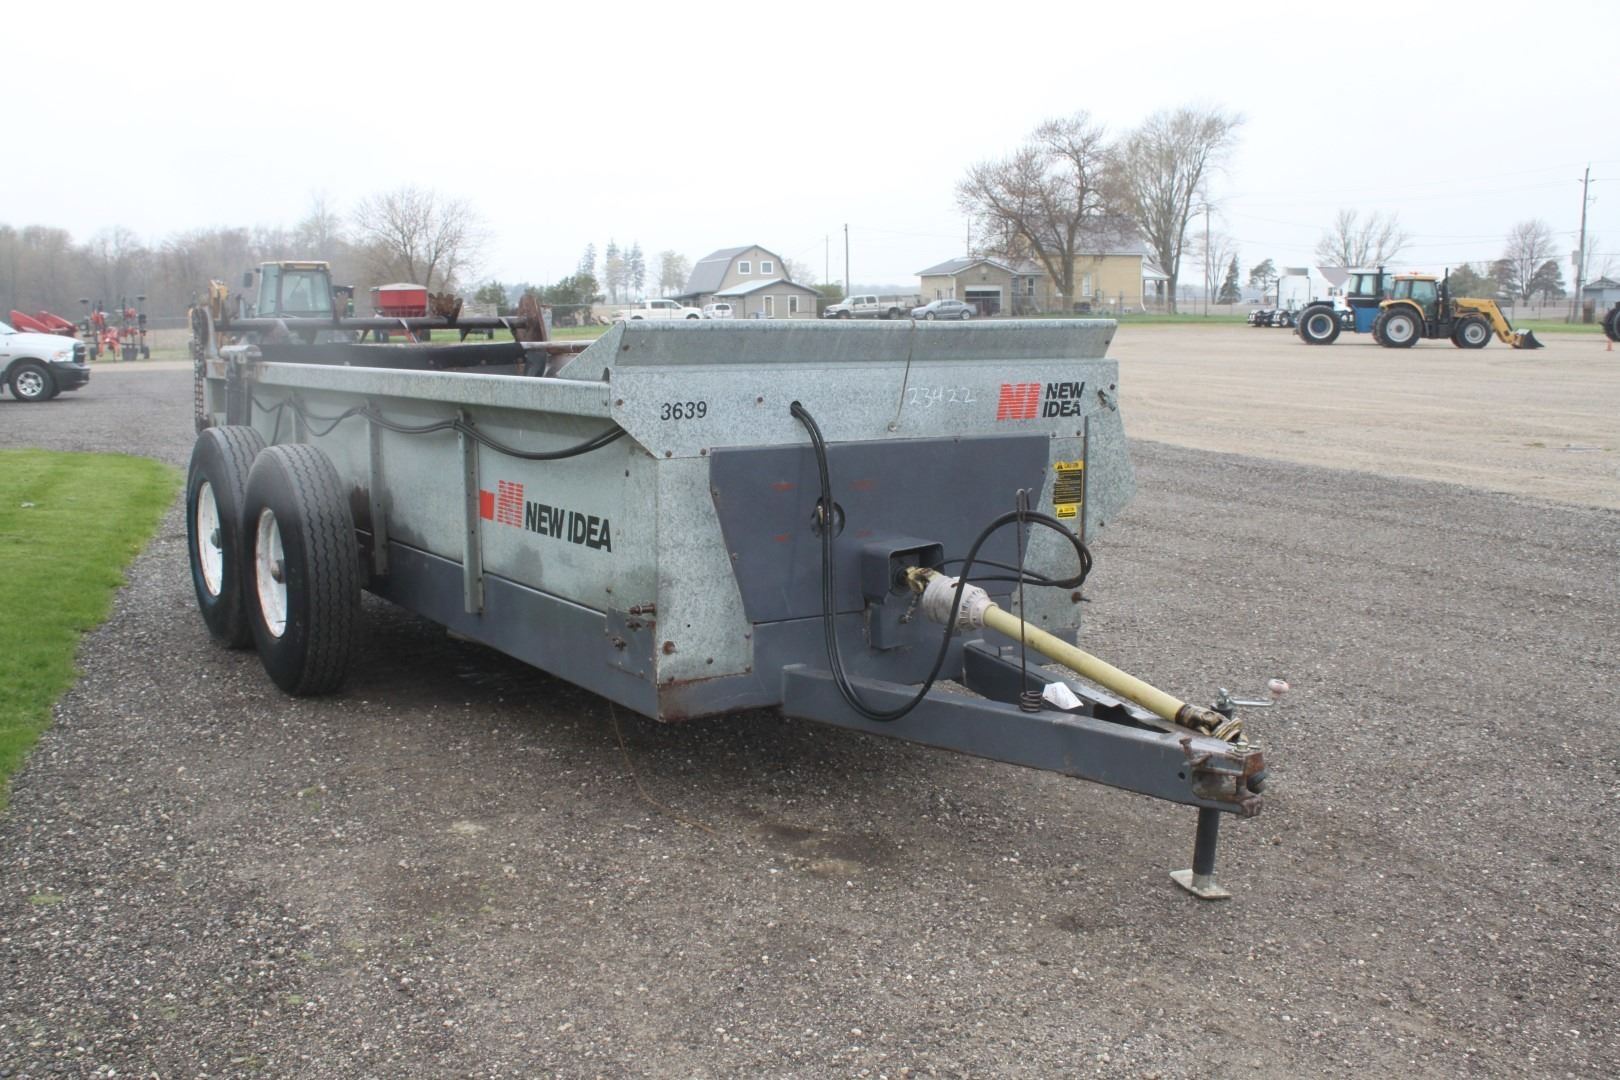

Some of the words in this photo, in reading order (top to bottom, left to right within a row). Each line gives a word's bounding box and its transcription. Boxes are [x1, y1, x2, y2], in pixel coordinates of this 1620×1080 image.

[907, 386, 976, 408] 23422
[1045, 381, 1085, 400] NEW
[660, 400, 708, 421] 3639
[1042, 400, 1081, 418] IDEA
[525, 500, 565, 539] NEW
[567, 510, 612, 553] IDEA
